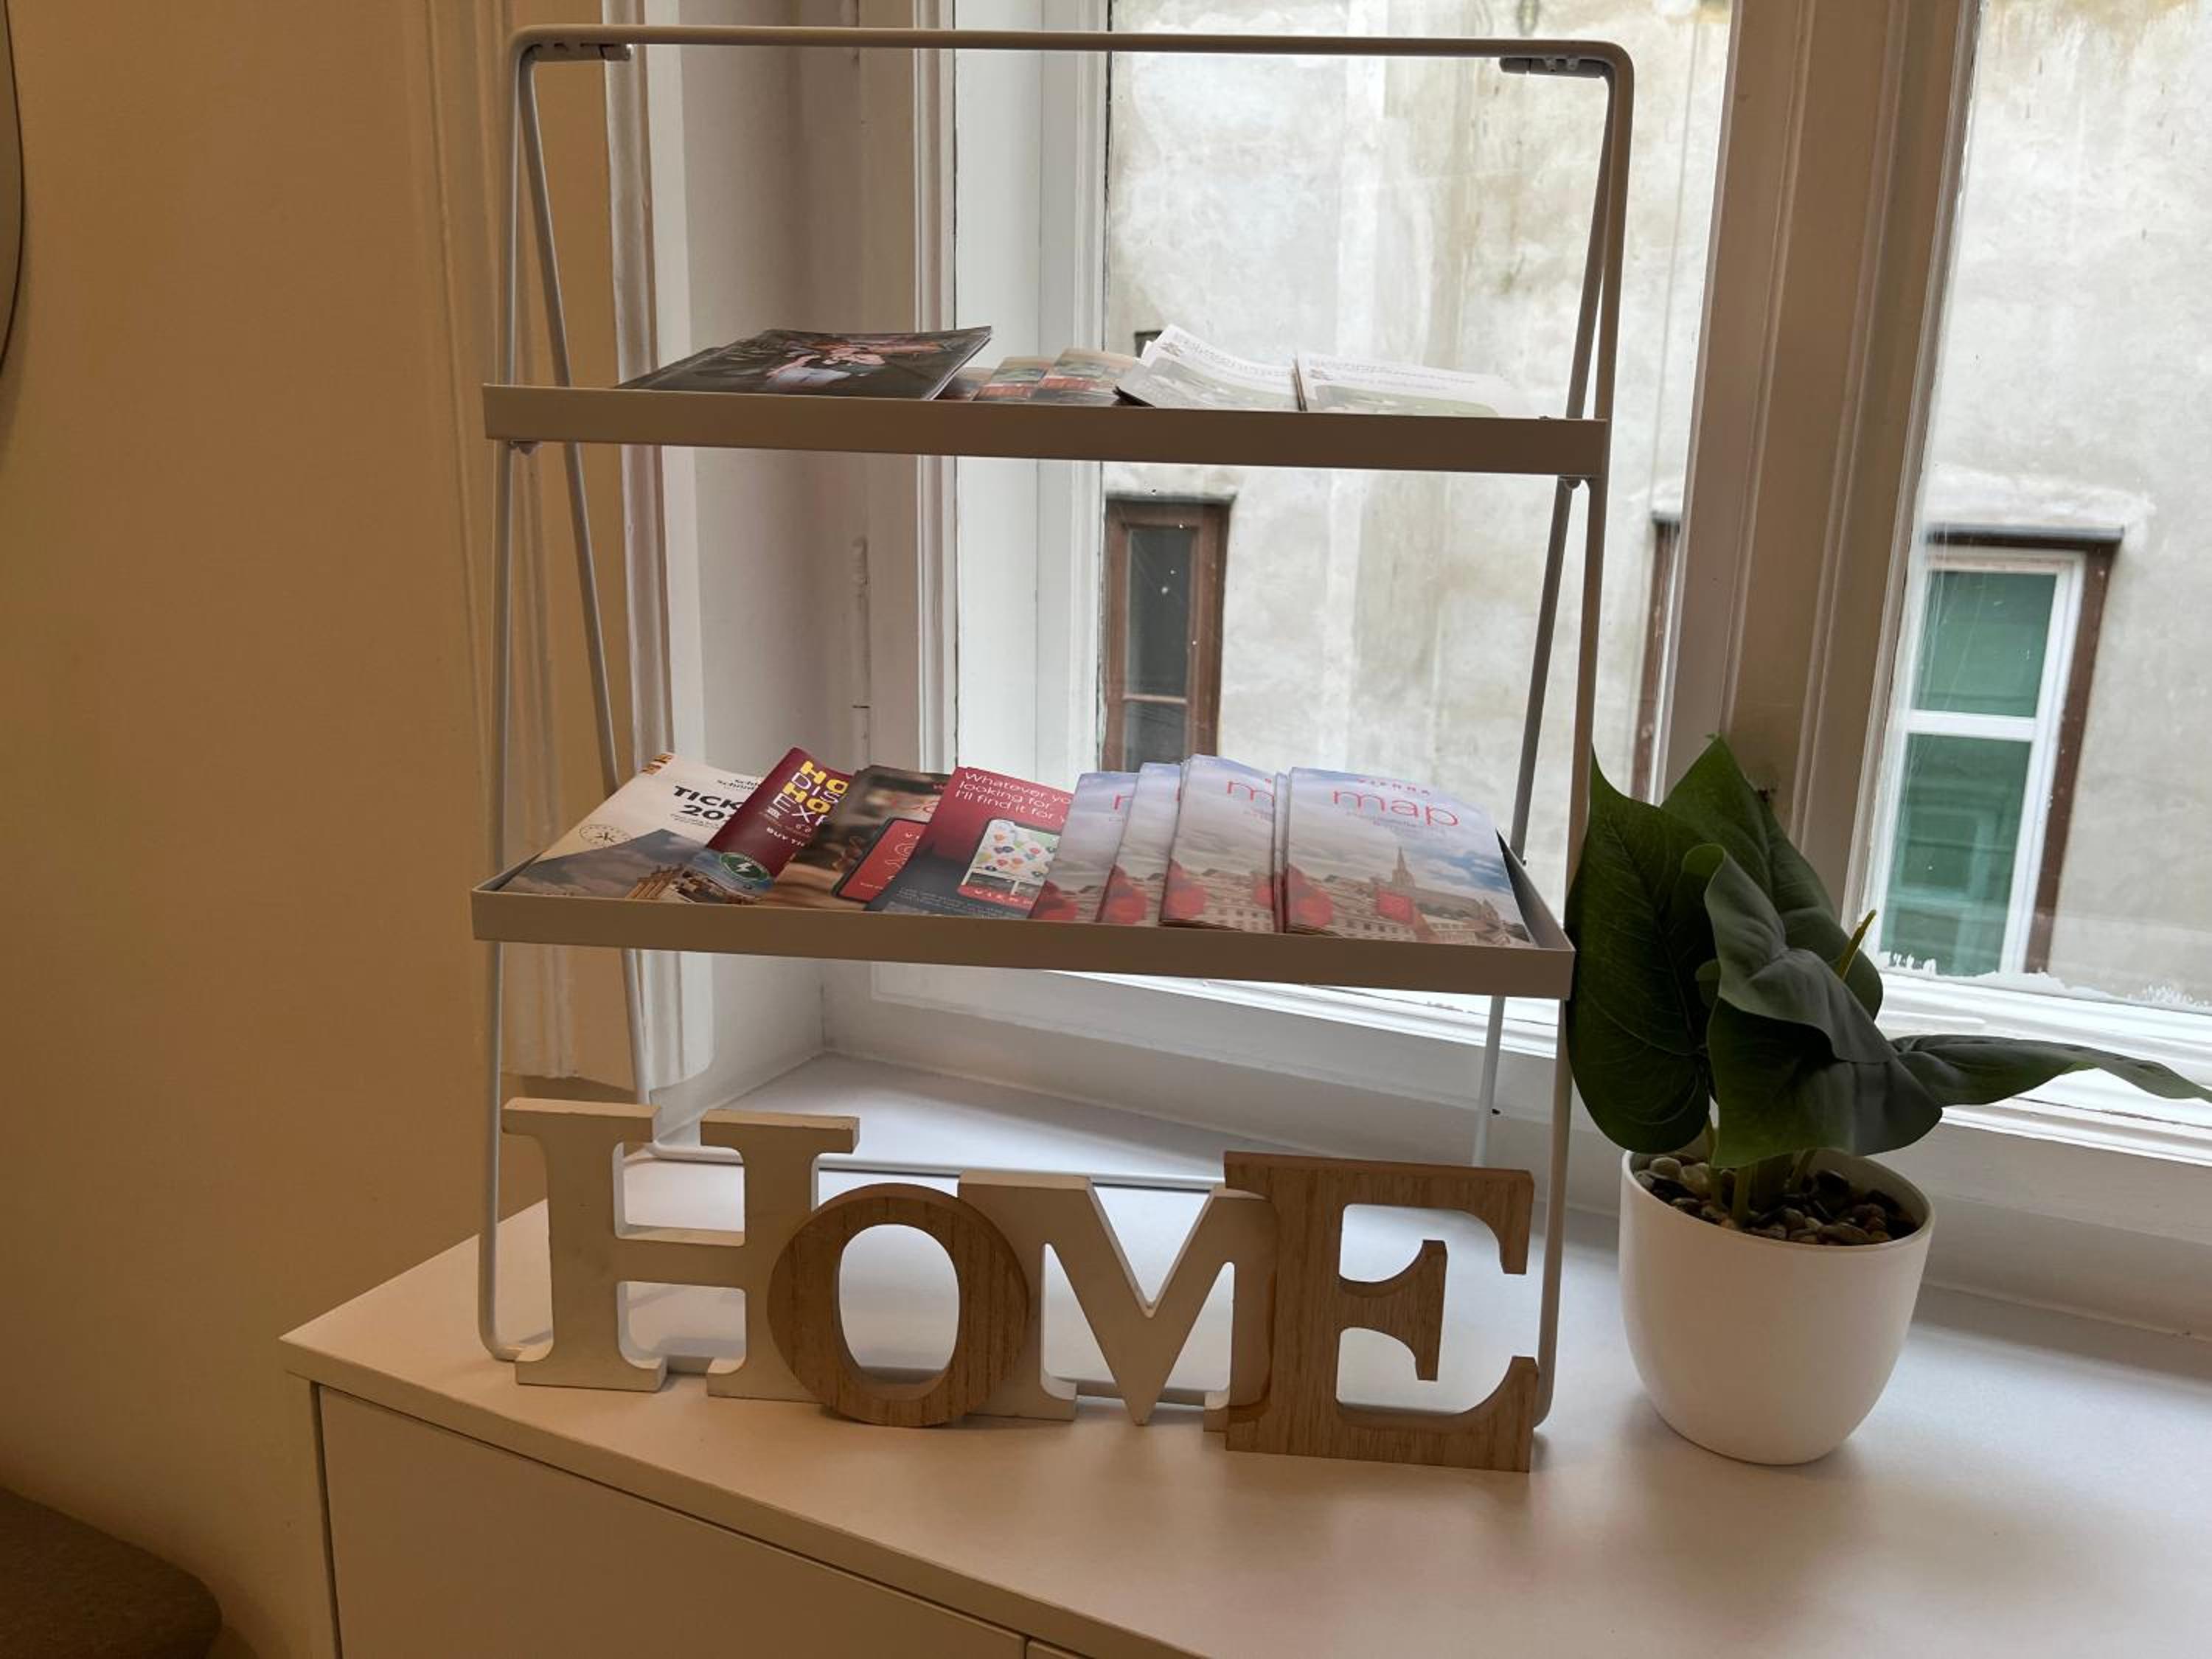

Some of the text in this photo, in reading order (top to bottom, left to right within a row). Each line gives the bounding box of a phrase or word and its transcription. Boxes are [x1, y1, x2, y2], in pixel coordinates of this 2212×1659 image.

[673, 785, 745, 810] TICK
[959, 780, 1023, 803] looking
[1028, 797, 1051, 810] for
[964, 771, 1047, 798] Whatever
[678, 804, 733, 821] 20
[955, 789, 973, 801] I'll
[977, 793, 1012, 810] find
[1015, 803, 1028, 814] it
[1031, 807, 1054, 821] for
[1333, 790, 1459, 827] map
[504, 1098, 1537, 1473] HOME
